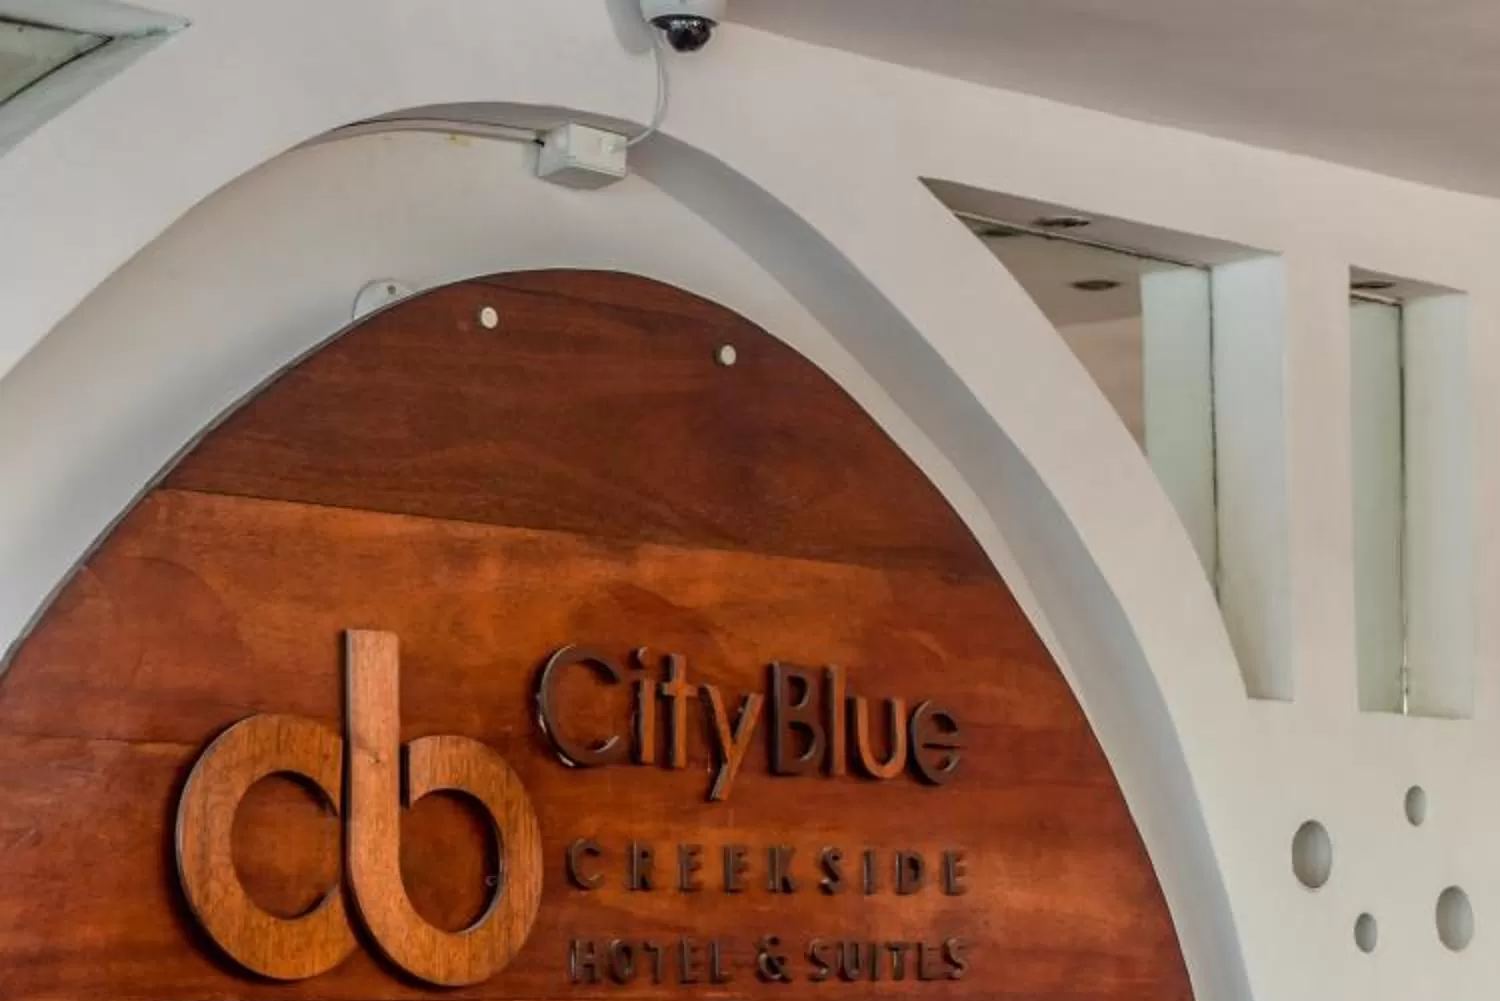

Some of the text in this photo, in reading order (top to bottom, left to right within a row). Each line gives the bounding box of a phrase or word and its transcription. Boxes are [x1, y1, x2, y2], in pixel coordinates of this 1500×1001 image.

[536, 644, 961, 801] CityBlue
[566, 838, 968, 897] CREEKSIDE
[569, 934, 970, 985] HOTEL & SUITES
